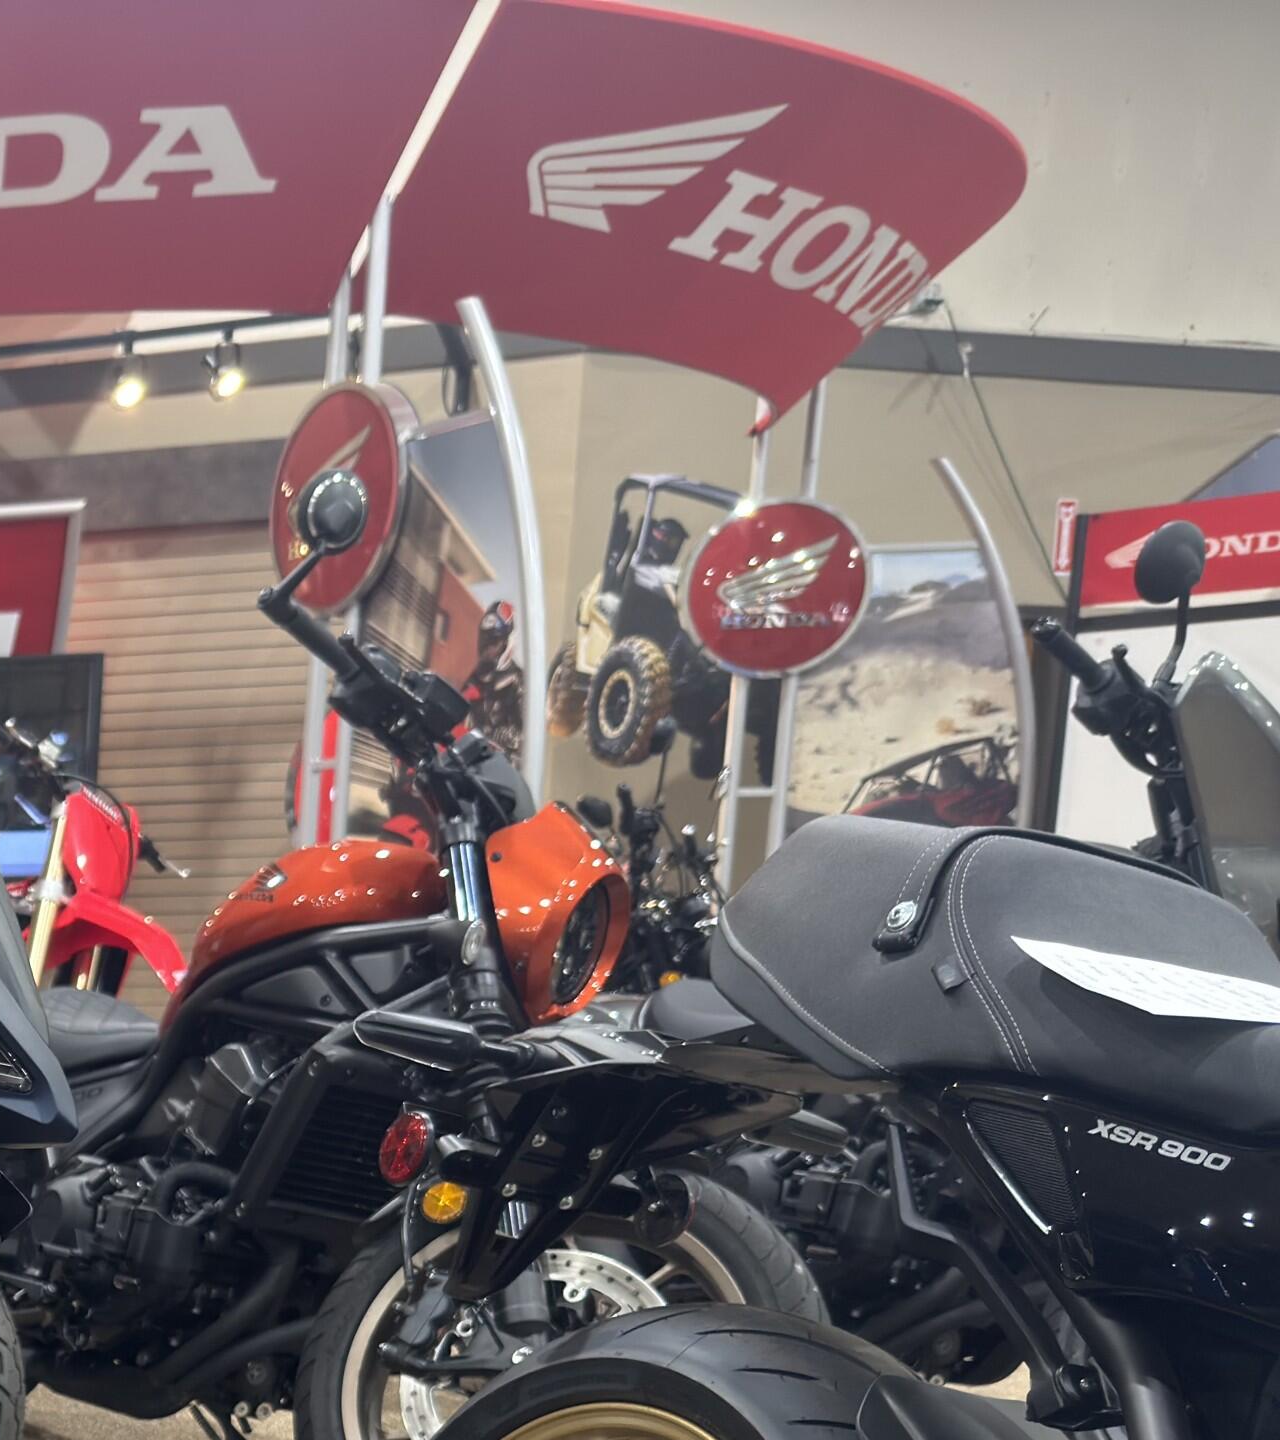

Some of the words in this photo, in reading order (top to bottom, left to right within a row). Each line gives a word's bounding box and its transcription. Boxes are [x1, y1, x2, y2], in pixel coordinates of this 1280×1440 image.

[668, 169, 930, 335] HOND
[1204, 531, 1280, 560] OND
[1088, 1119, 1158, 1151] XSR
[1157, 1139, 1232, 1171] 900
